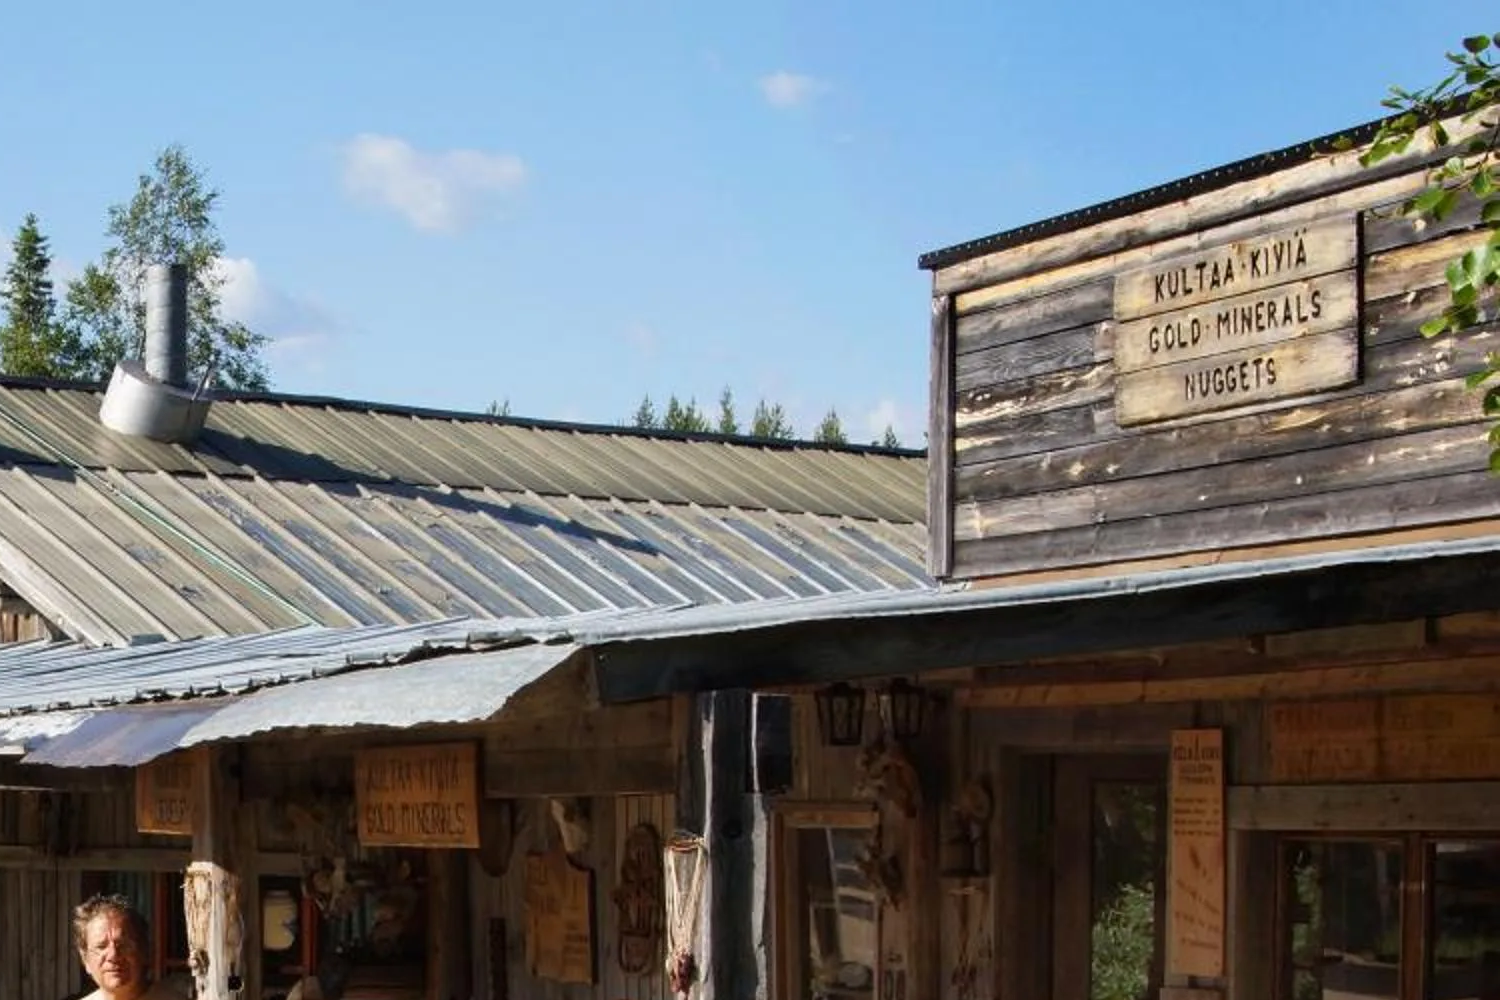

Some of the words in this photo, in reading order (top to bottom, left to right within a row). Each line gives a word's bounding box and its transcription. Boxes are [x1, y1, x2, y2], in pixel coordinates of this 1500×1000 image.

[1154, 259, 1235, 303] KULTAA
[1149, 318, 1201, 352] GOLD
[1217, 290, 1322, 339] MINERALS
[1185, 357, 1276, 400] NUGGETS
